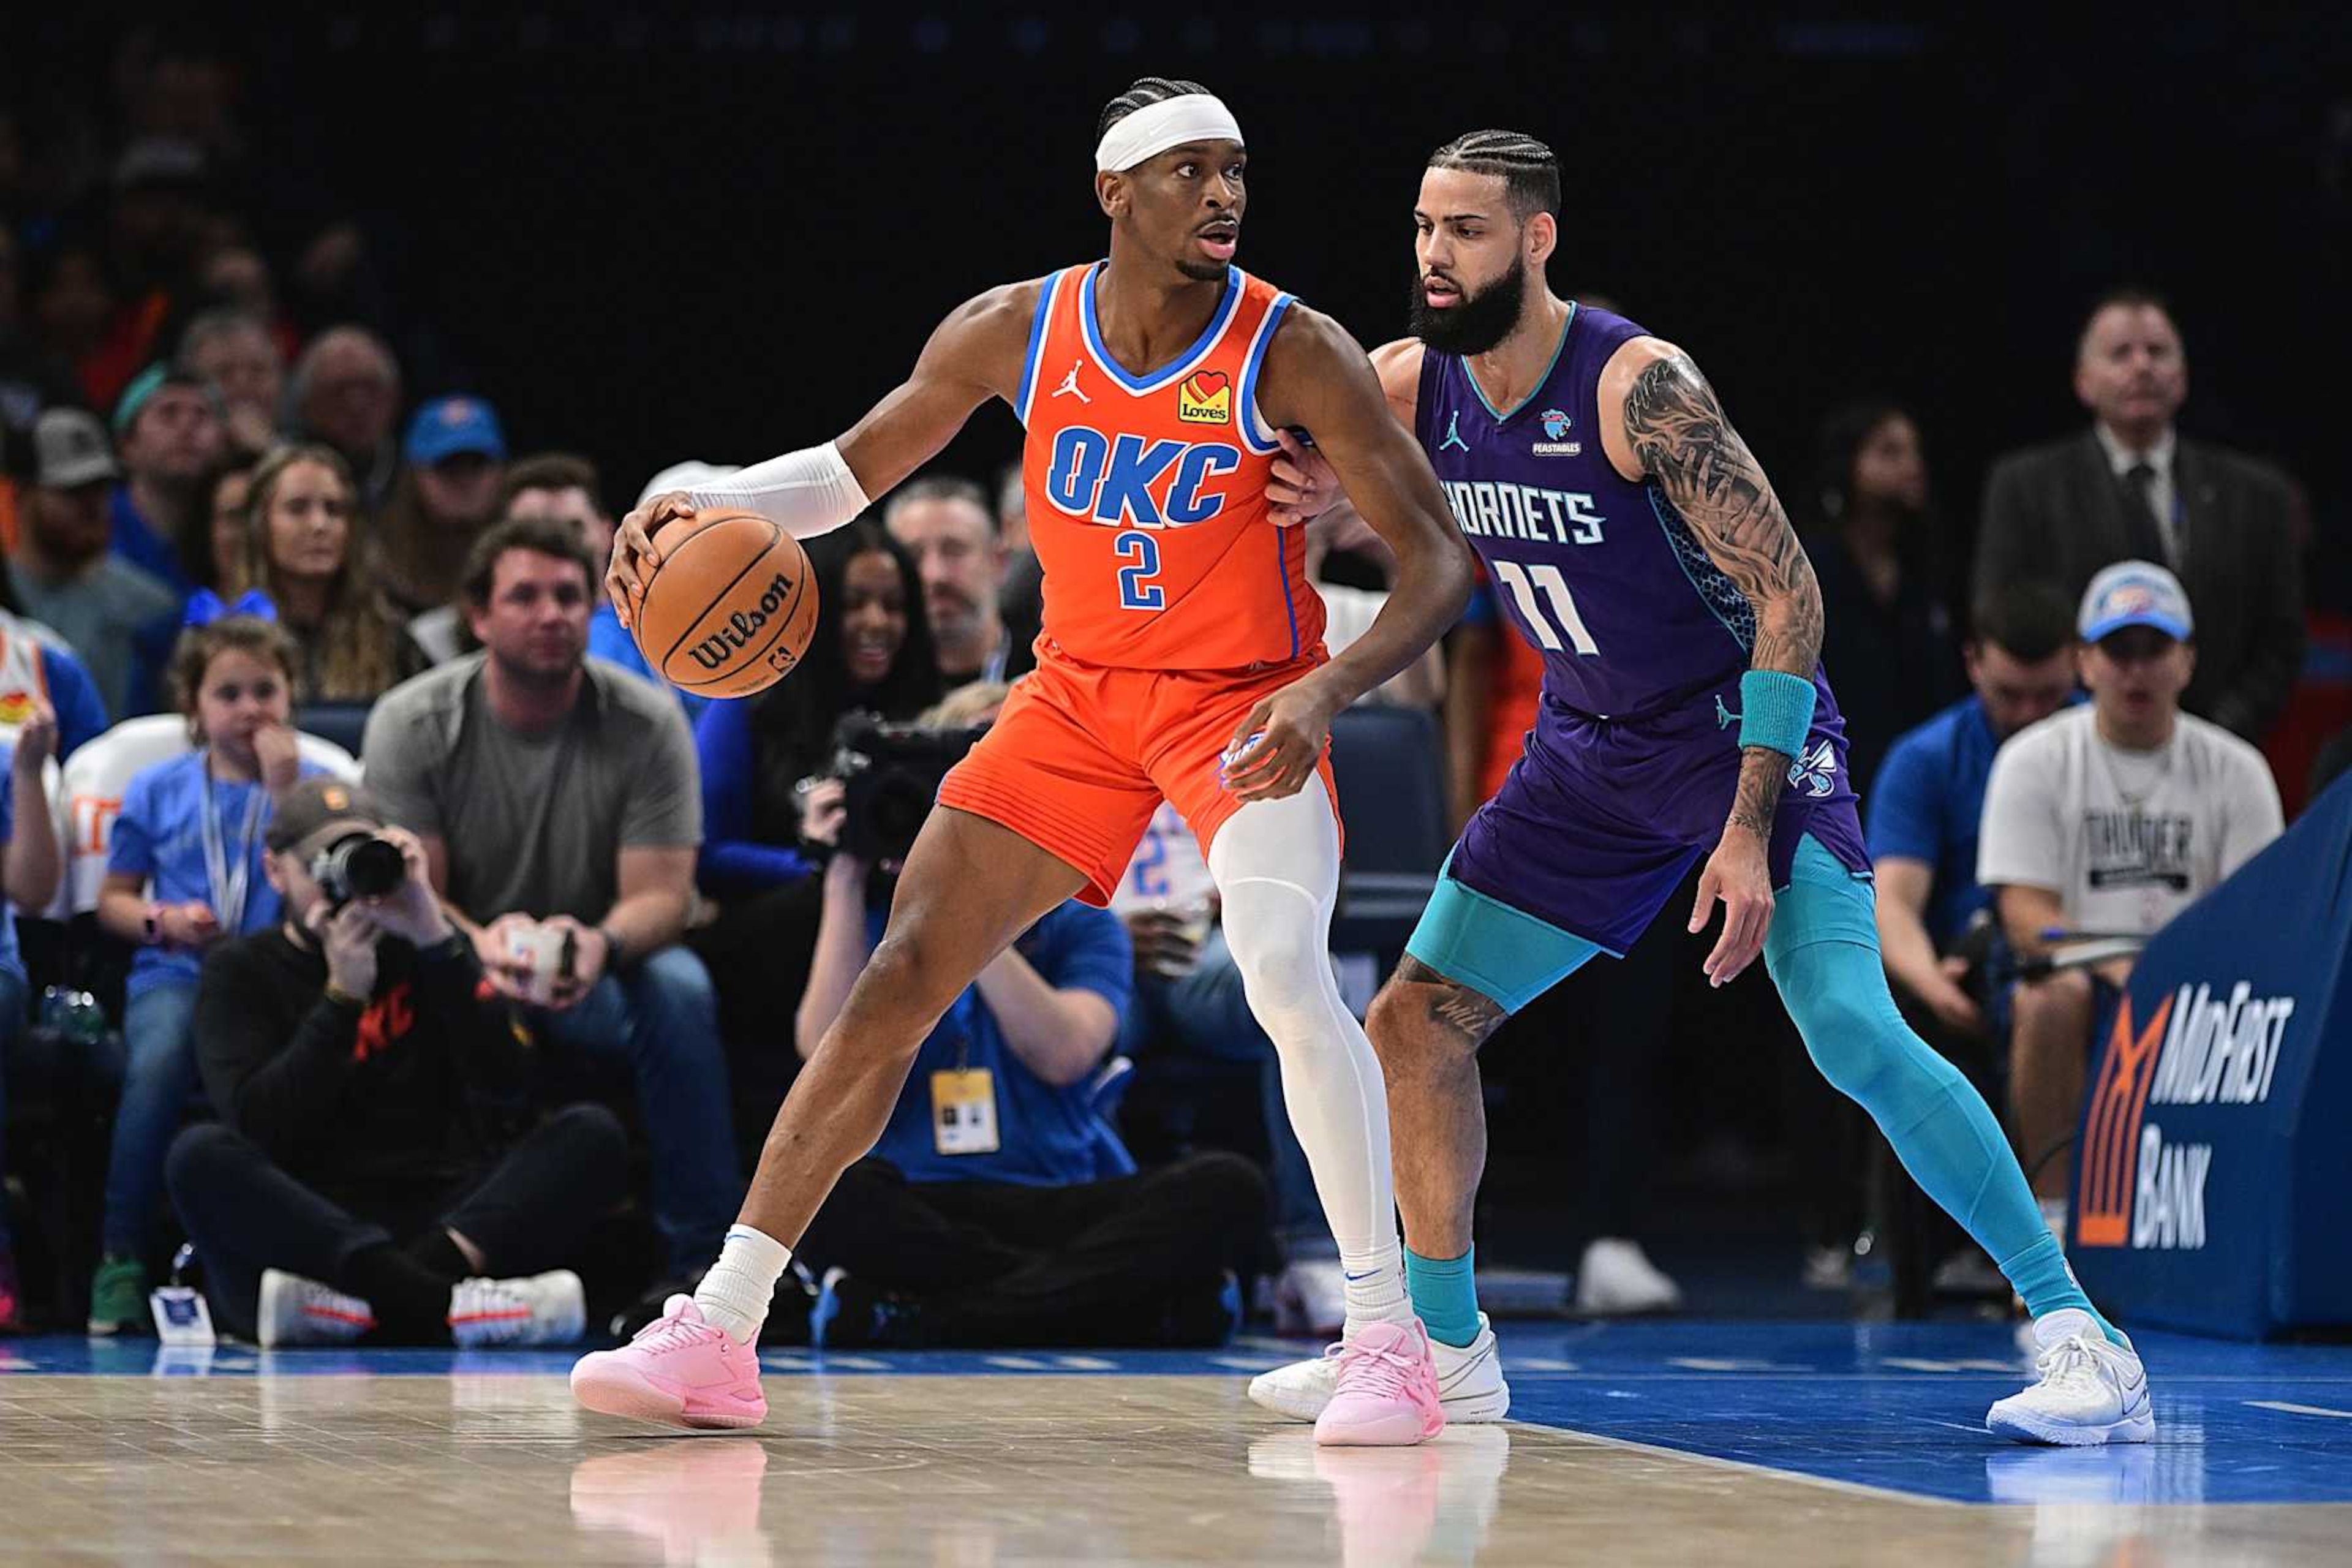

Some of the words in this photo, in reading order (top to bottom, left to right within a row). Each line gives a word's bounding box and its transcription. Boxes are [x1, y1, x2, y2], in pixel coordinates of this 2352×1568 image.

[1045, 425, 1242, 530] OKC
[1532, 442, 1580, 453] FEASTABLES
[1114, 530, 1164, 611] 2
[1493, 560, 1600, 657] 11
[688, 571, 793, 669] Wilson
[1133, 827, 1169, 896] 2
[2084, 811, 2193, 865] THUNDER
